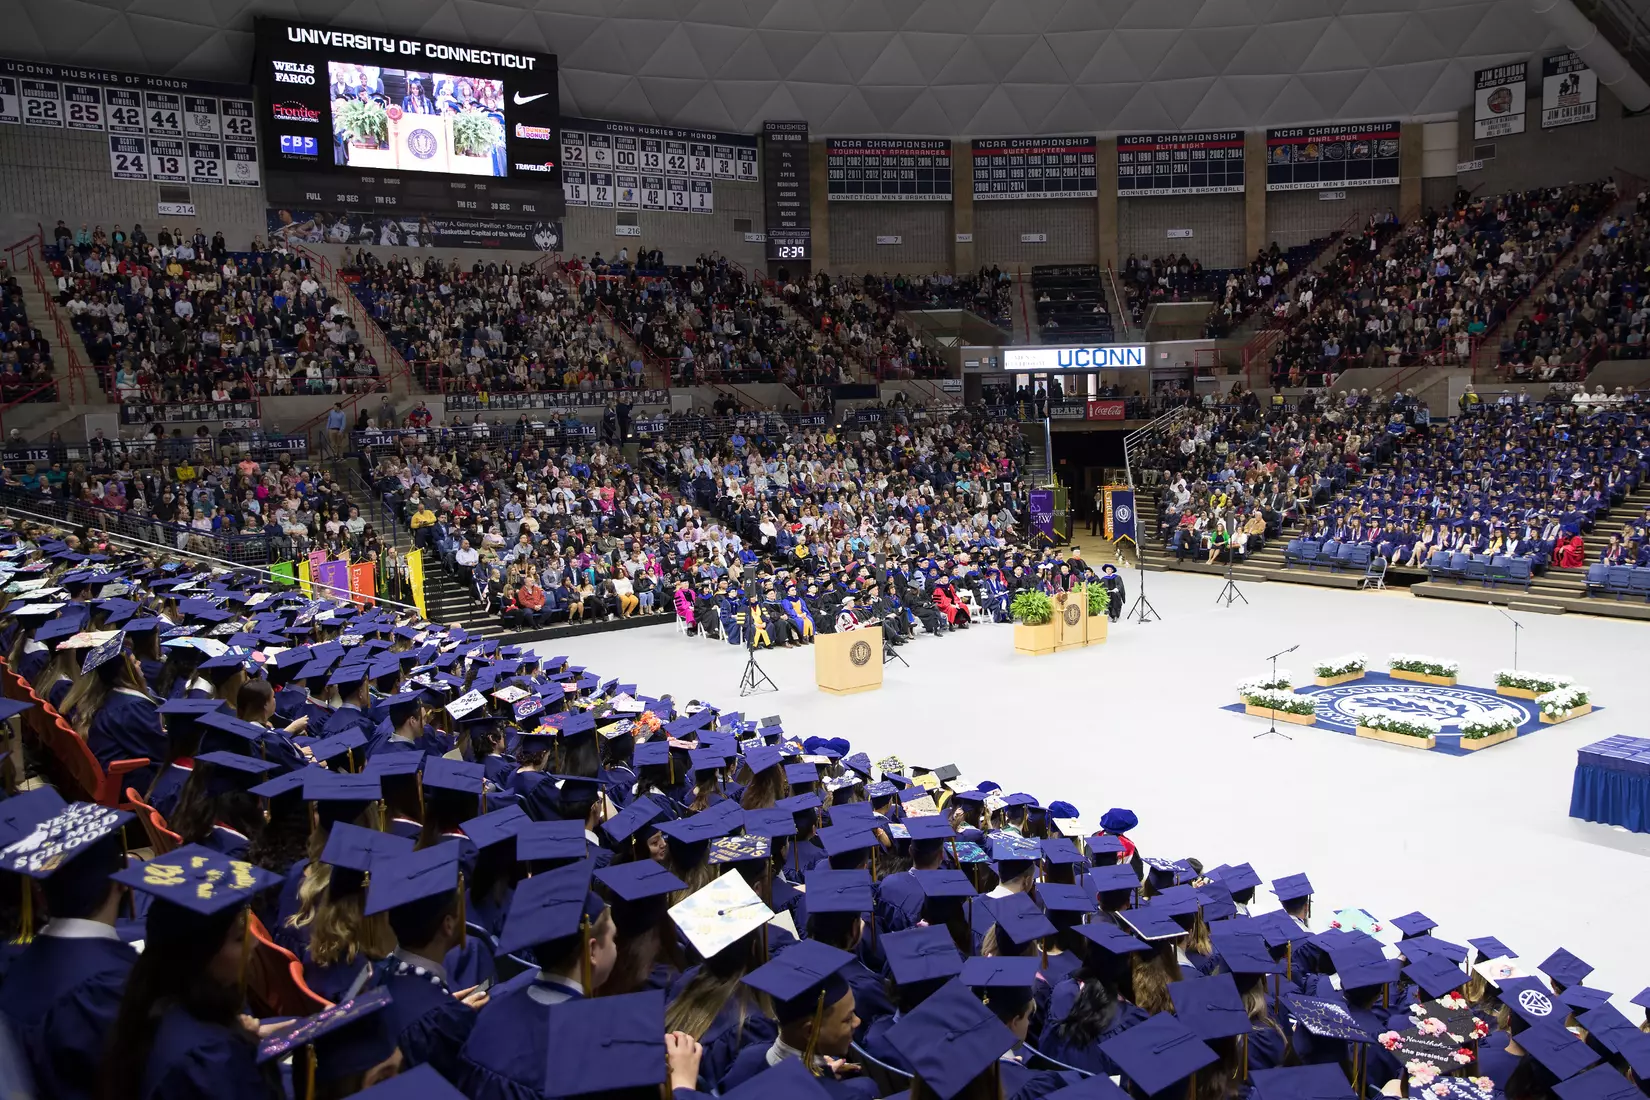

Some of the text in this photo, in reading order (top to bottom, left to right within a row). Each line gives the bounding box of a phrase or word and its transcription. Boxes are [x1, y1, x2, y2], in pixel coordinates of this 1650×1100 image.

[288, 26, 536, 70] UNIVERSITY OF CONNECTICUT
[272, 60, 315, 74] WELLS
[1479, 63, 1525, 82] JIM CALHOUN
[7, 63, 188, 89] UCONN HUSKIES OF HONOR
[274, 72, 316, 86] FARGO
[1477, 80, 1498, 89] CLASS
[28, 99, 57, 118] 22
[70, 103, 99, 122] 25
[272, 103, 321, 118] Frontier
[1547, 105, 1590, 120] JIM CALHOUN
[112, 107, 139, 125] 42
[151, 111, 178, 128] 44
[273, 115, 319, 123] COMMUNICATIONS
[227, 118, 252, 135] 42
[606, 124, 717, 141] UCONN HUSKIES OF HONOR
[777, 123, 806, 131] HUSKIES
[1274, 123, 1392, 138] NCAA CHAMPIONSHIP
[834, 140, 945, 148] NCAA CHAMPIONSHIP
[979, 138, 1089, 148] NCAA CHAMPIONSHIP
[1124, 133, 1237, 144] NCAA CHAMPIONSHIP
[564, 146, 582, 161] 52
[618, 151, 635, 165] 00
[644, 153, 659, 167] 13
[116, 154, 143, 172] 24
[157, 157, 179, 174] 13
[194, 159, 217, 177] 22
[515, 163, 548, 172] TRAVELERS
[668, 156, 685, 169] 42
[695, 158, 705, 171] 34
[719, 160, 729, 173] 32
[742, 162, 752, 175] 50
[1174, 164, 1188, 173] 2014
[1469, 161, 1482, 169] 218
[847, 170, 897, 179] 2011 2012 2014
[570, 185, 580, 199] 15
[1011, 181, 1025, 191] 2014
[306, 193, 322, 201] FULL
[337, 194, 359, 203] 30 SEC
[375, 196, 396, 204] TM FLS
[596, 187, 607, 200] 22
[648, 191, 658, 204] 42
[672, 192, 683, 206] 13
[457, 200, 477, 208] TM FLS
[491, 202, 510, 210] 30 SEC
[699, 194, 704, 207] 3
[176, 205, 194, 214] 214
[522, 204, 536, 212] FULL
[432, 220, 448, 228] Harry
[456, 221, 479, 229] Gampel
[628, 227, 640, 235] 216
[440, 228, 470, 236] Basketball
[779, 246, 804, 258] 12:39
[1058, 348, 1141, 367] UCONN
[1050, 406, 1085, 415] BEAR'S
[1094, 404, 1123, 416] Coca-Cola
[813, 416, 825, 424] 116
[581, 426, 596, 434] 114
[651, 423, 664, 431] 116
[287, 439, 306, 448] 113
[375, 435, 393, 445] 114
[3, 450, 49, 460] SEC 113
[49, 808, 108, 837] STOP
[65, 813, 119, 840] MED
[14, 826, 112, 870] SCHOOL
[712, 836, 766, 857] loans
[1402, 1047, 1449, 1062] she persisted
